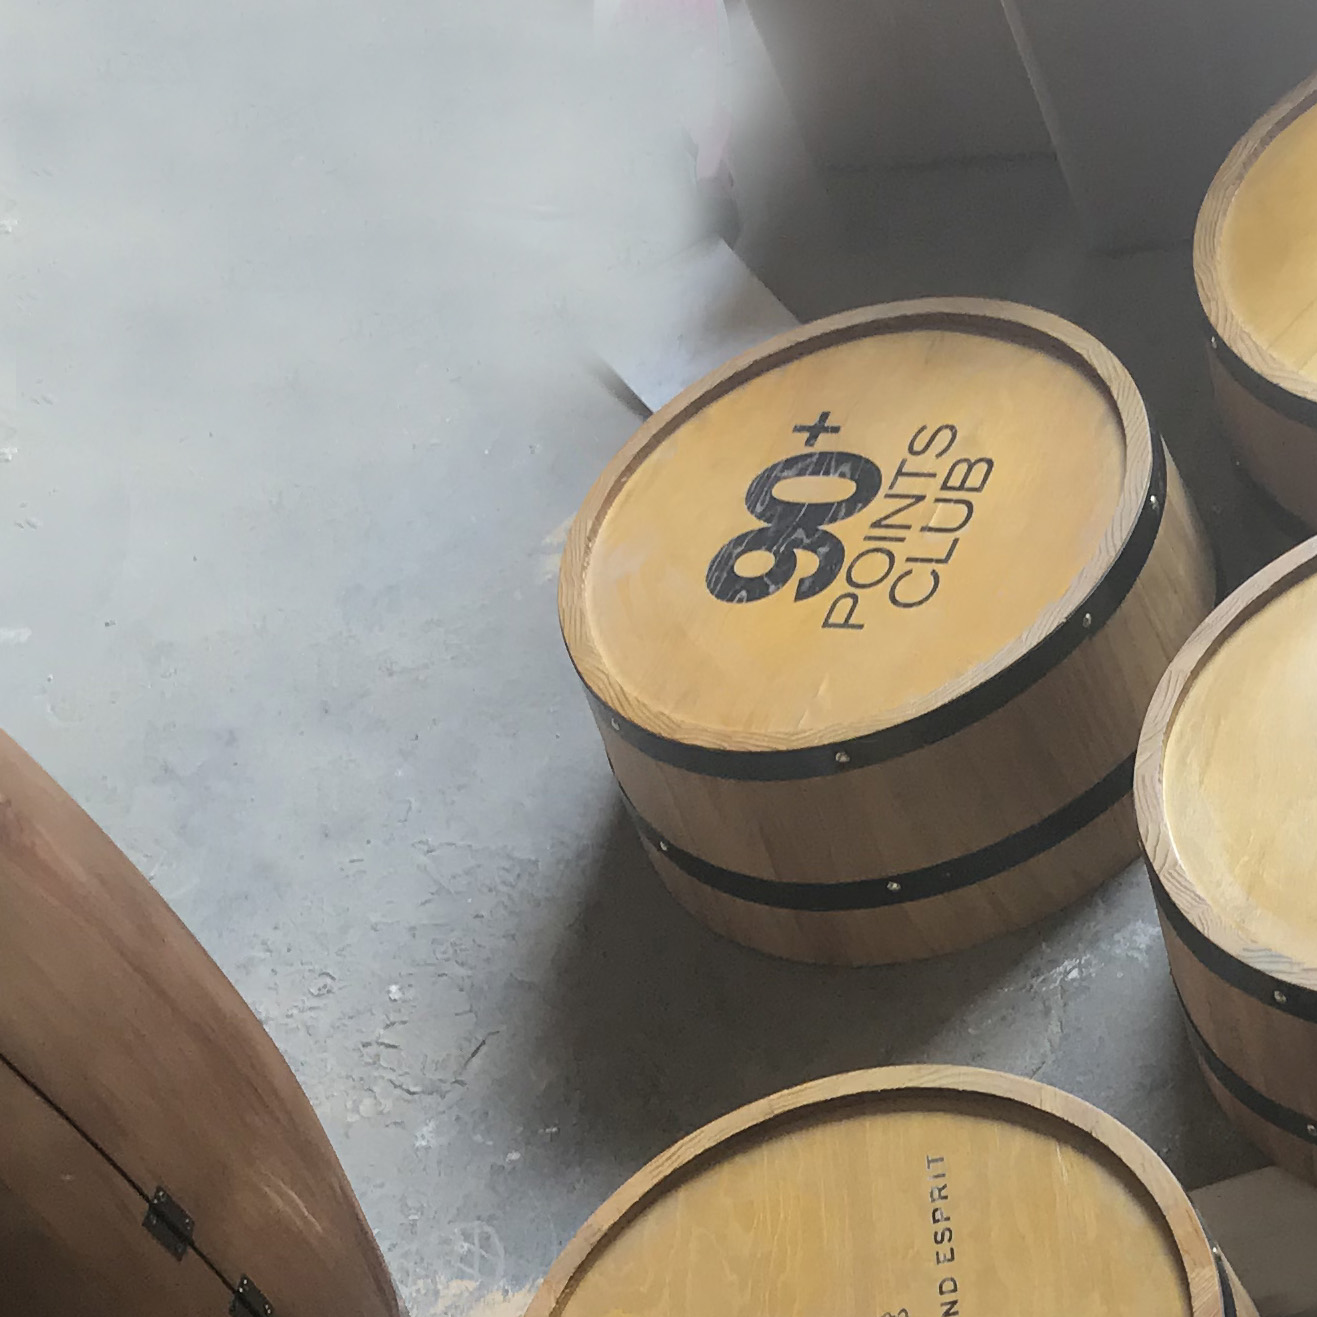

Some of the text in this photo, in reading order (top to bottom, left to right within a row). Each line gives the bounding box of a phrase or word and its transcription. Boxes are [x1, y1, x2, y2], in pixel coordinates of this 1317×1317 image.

[821, 423, 958, 631] POINTS
[888, 456, 995, 609] CLUB
[926, 1153, 957, 1266] ESPRIT
